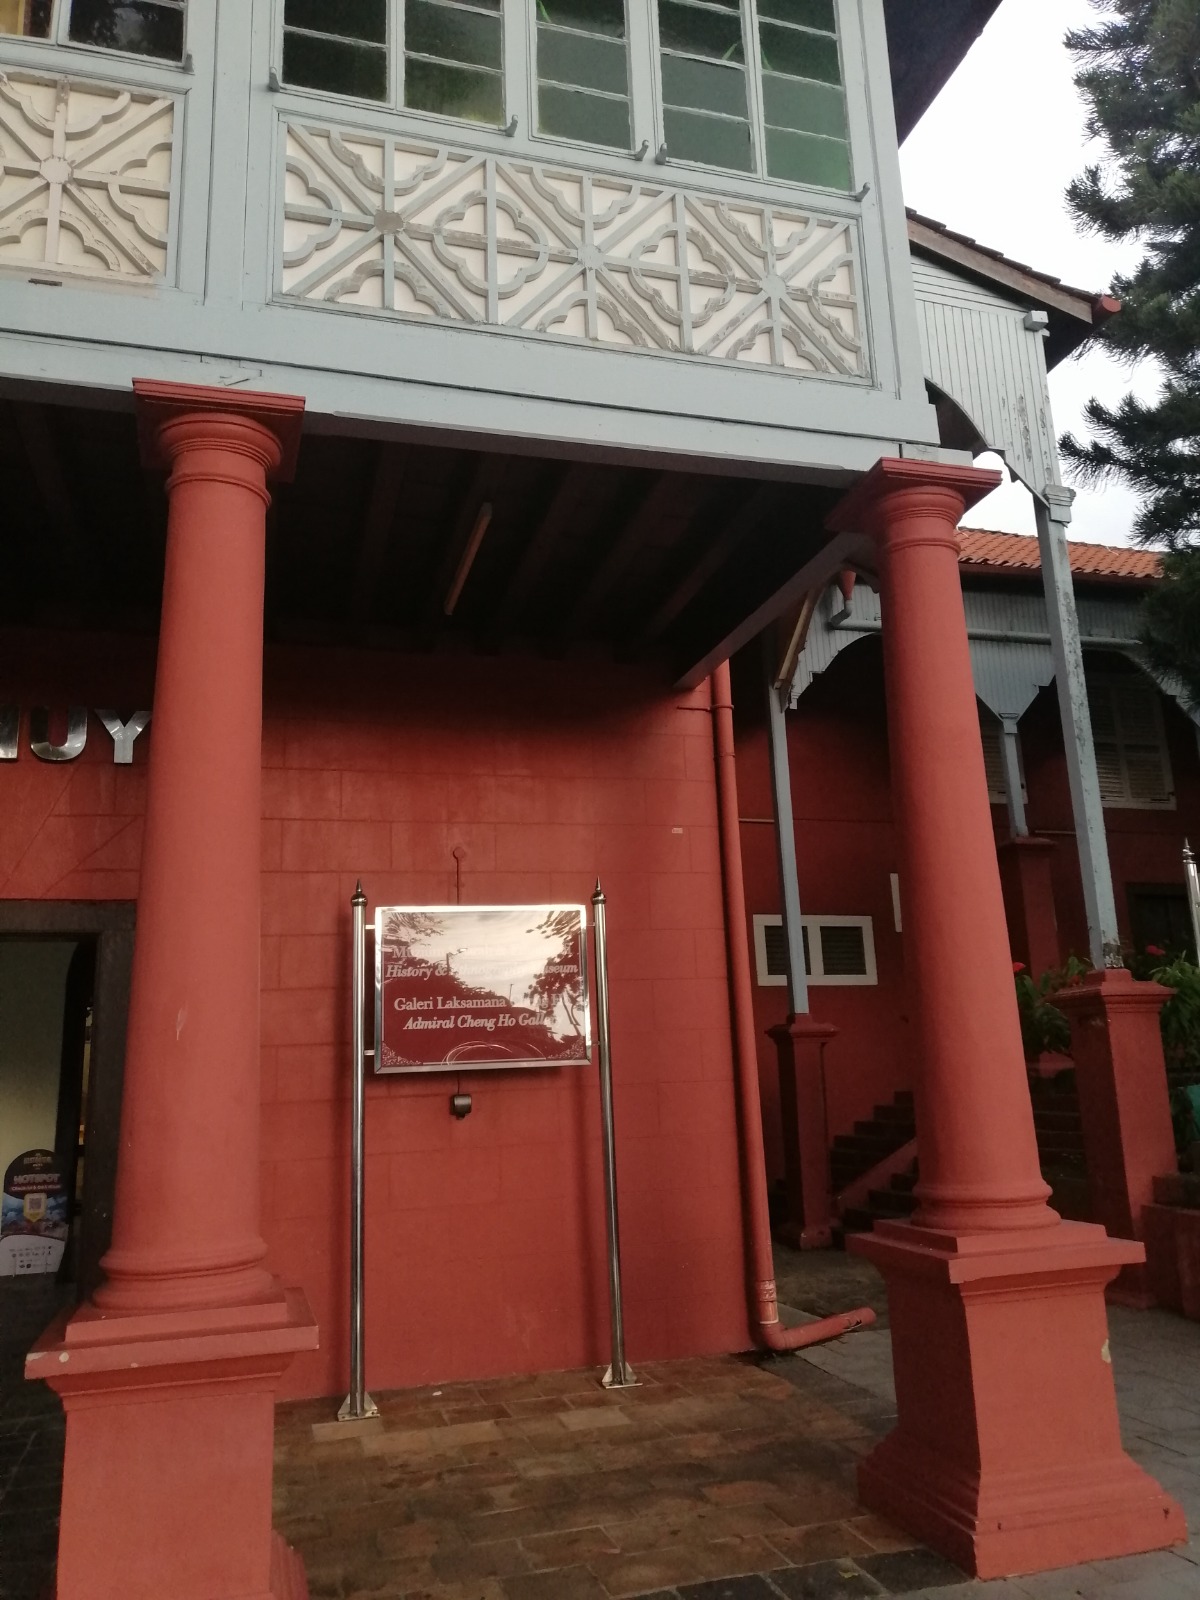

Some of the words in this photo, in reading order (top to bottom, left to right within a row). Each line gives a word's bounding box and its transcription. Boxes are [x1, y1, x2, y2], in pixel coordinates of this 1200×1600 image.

[385, 964, 433, 981] History
[394, 996, 433, 1012] Galeri
[436, 994, 507, 1010] Laksamana
[403, 1015, 455, 1031] Admiral
[457, 1013, 496, 1031] Cheng
[497, 1013, 516, 1027] Ho
